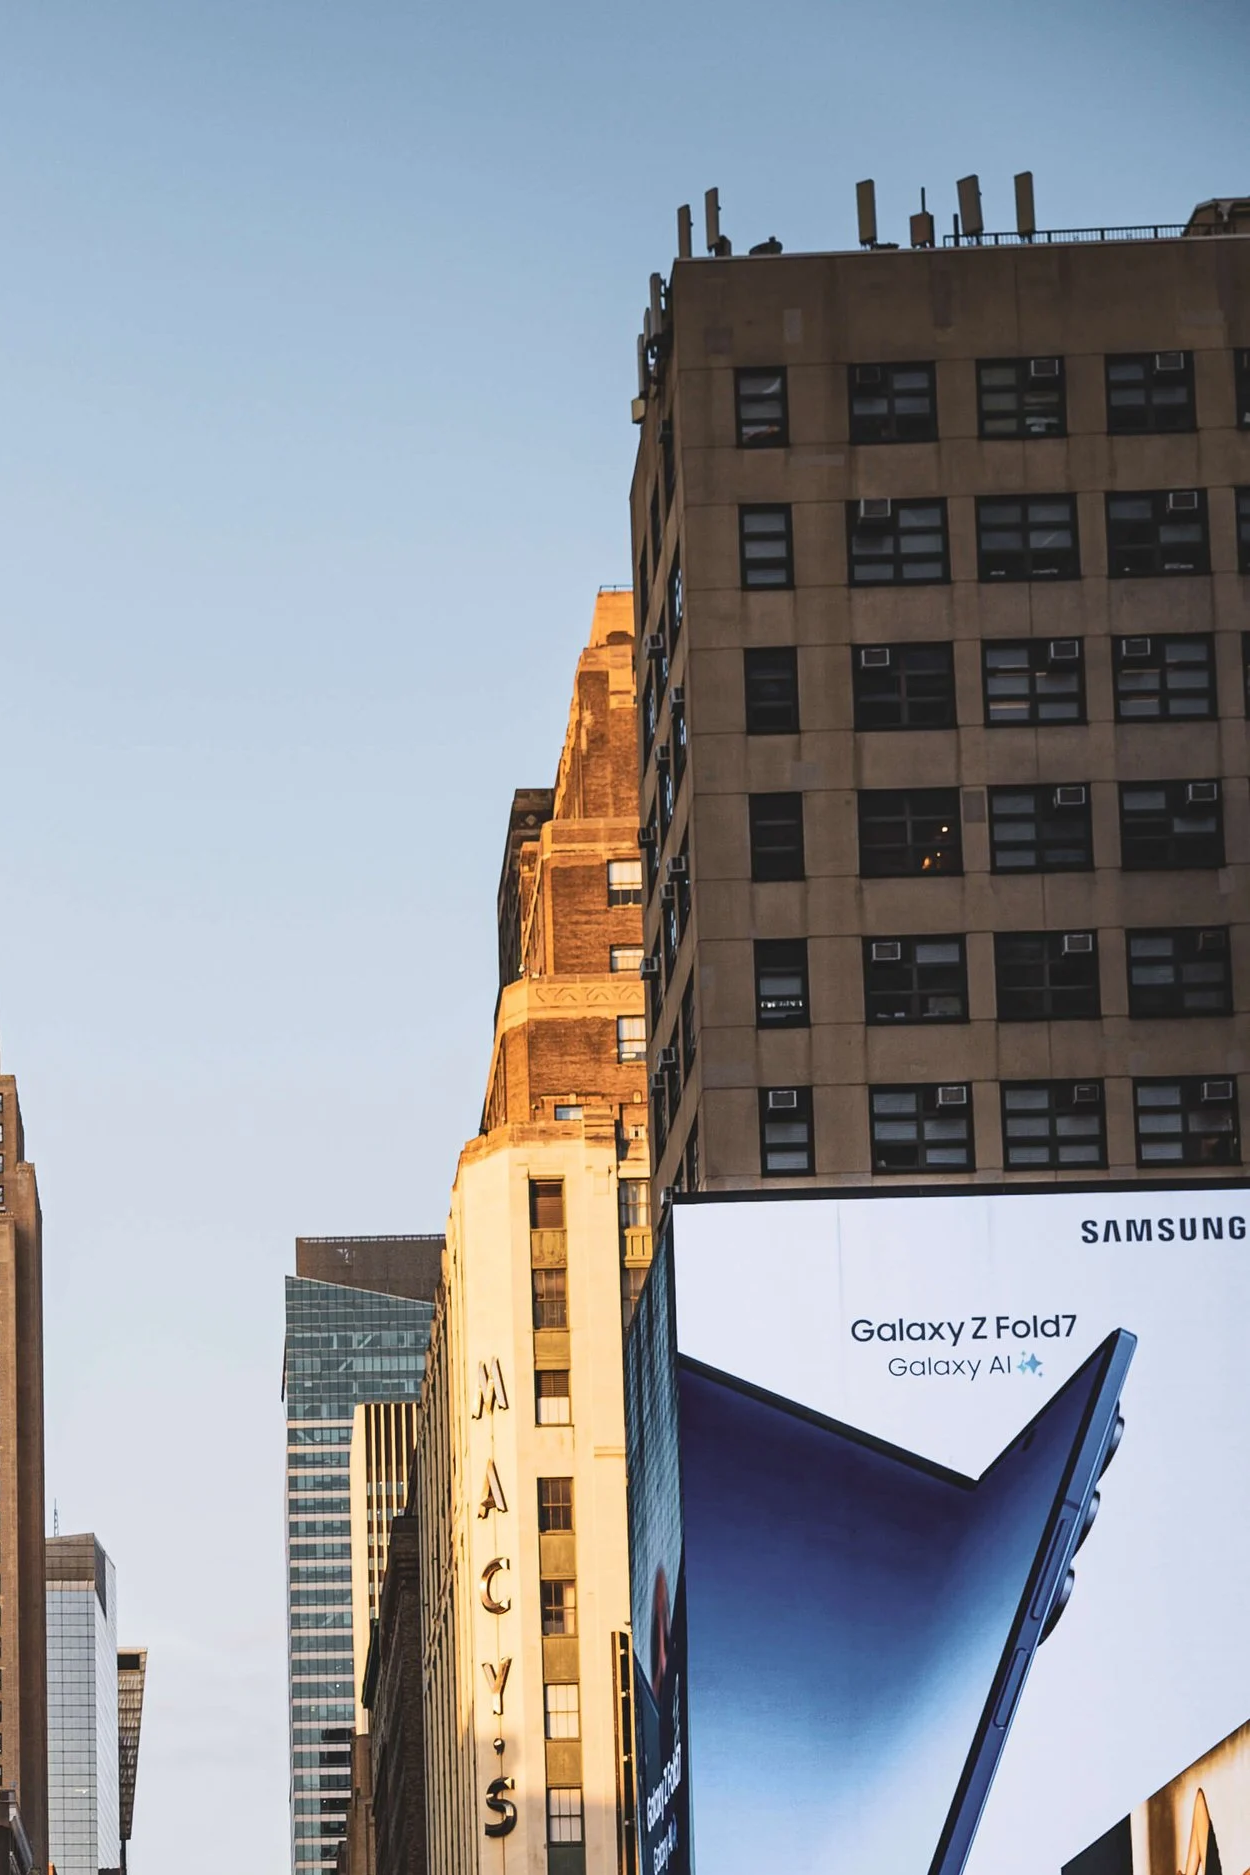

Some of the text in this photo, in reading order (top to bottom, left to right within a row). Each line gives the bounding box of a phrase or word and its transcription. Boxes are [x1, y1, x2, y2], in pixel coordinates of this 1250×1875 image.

[1081, 1216, 1248, 1244] SAMSUNG
[851, 1314, 1078, 1347] Galaxy Z Fold7
[888, 1354, 1012, 1381] Galaxy AI
